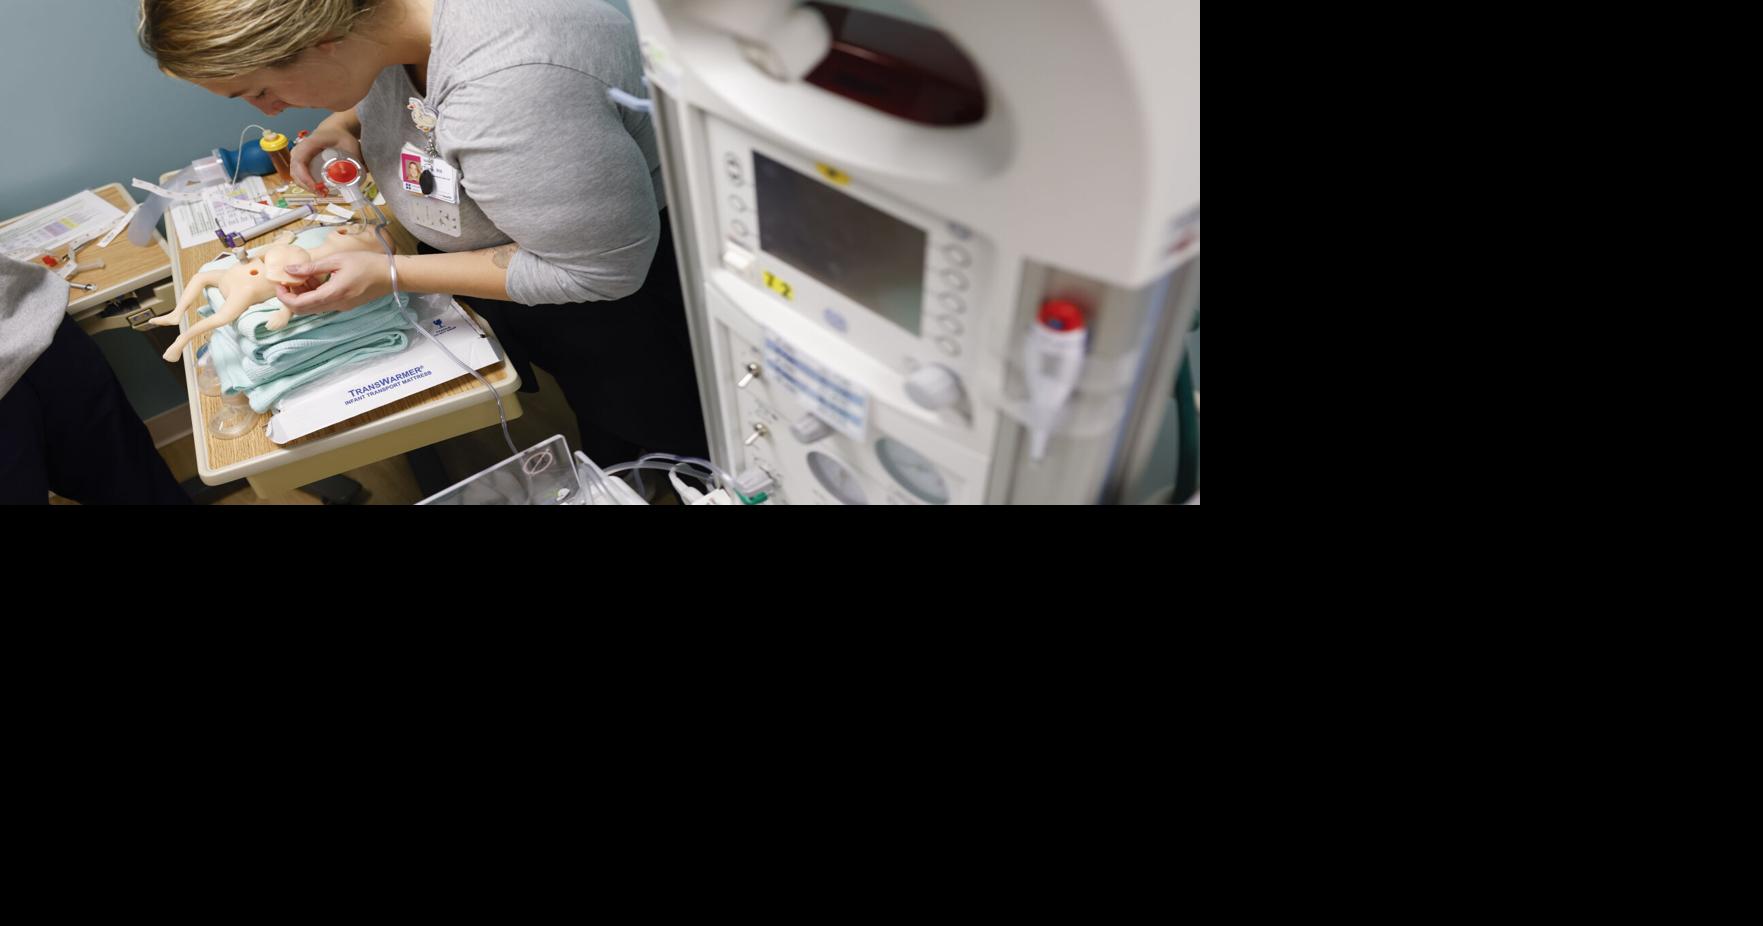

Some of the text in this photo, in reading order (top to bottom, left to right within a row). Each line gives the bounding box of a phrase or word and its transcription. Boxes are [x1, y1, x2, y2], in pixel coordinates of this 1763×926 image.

[344, 370, 433, 406] INFANT TRANSPORT MATTRESS
